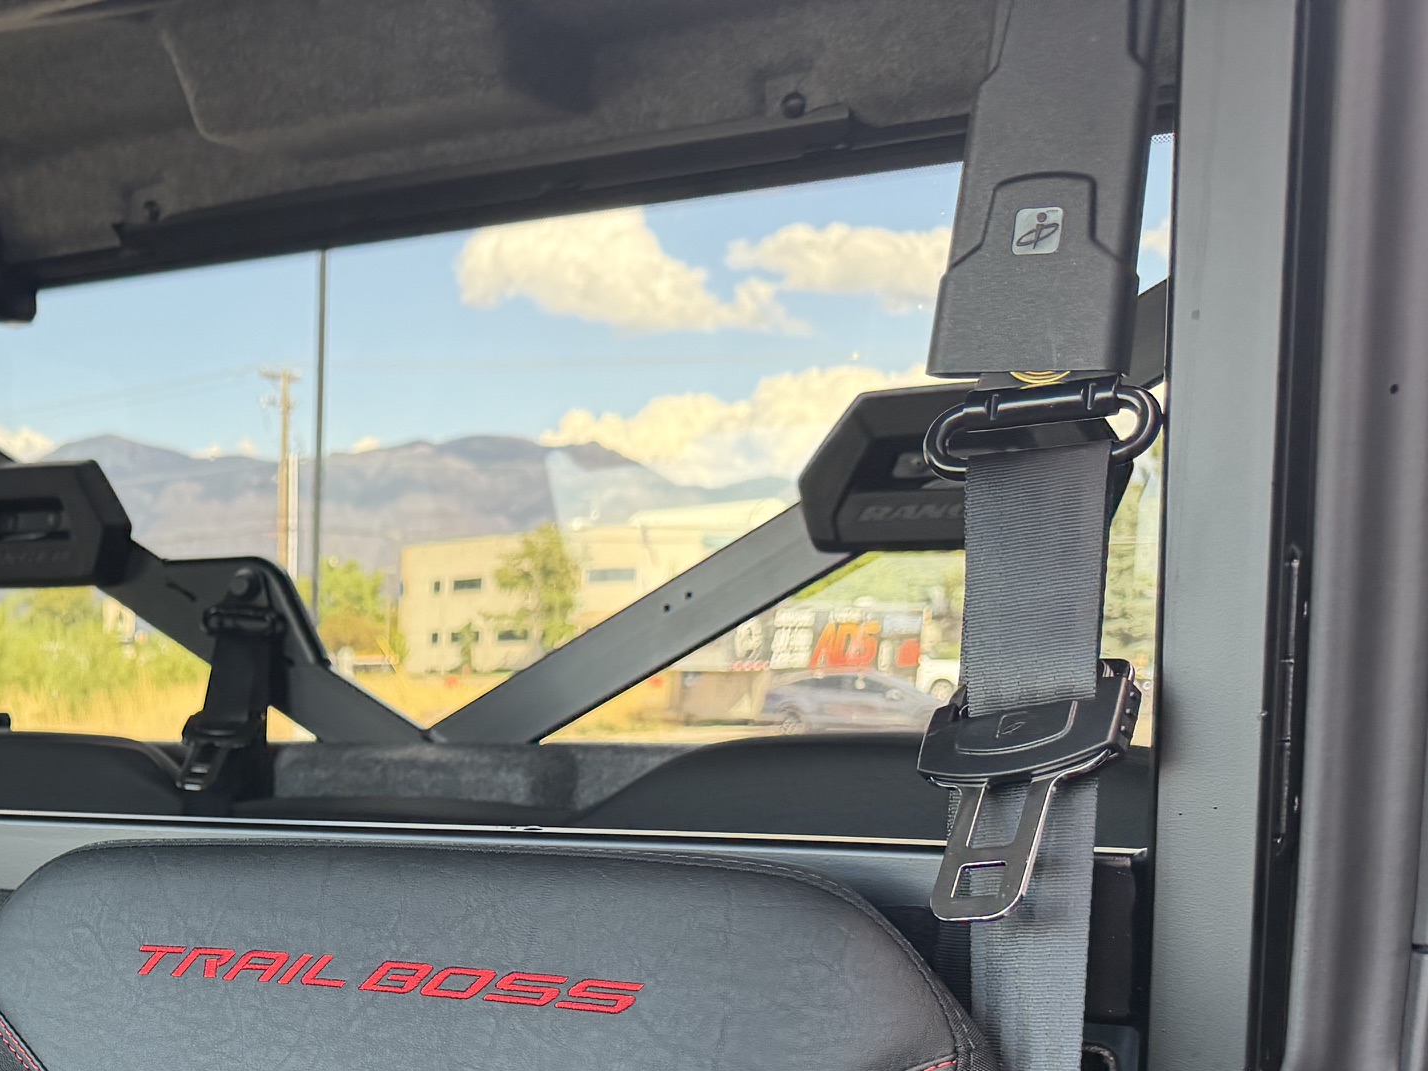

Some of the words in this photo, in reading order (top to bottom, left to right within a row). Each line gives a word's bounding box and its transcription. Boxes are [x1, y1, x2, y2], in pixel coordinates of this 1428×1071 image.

[857, 503, 963, 522] RAN
[139, 944, 346, 988] TRAIL
[358, 960, 645, 1014] BOSS
